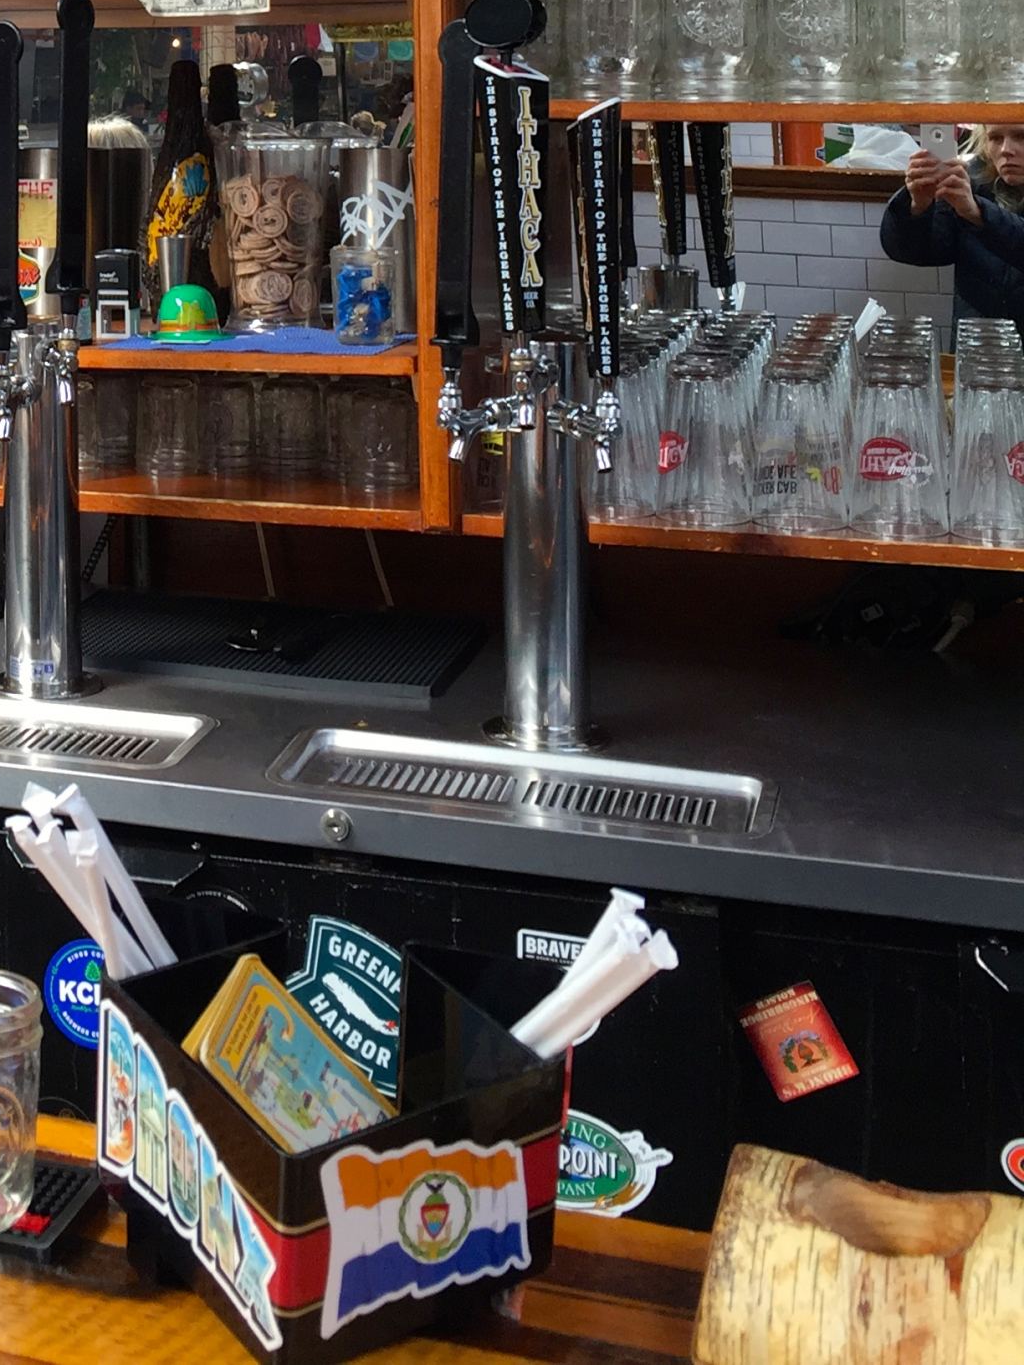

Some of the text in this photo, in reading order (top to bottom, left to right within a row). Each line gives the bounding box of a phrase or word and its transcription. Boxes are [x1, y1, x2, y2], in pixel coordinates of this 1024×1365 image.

[484, 76, 515, 331] THE SPIRIT OF THE FINGER LAKES
[517, 86, 544, 287] ITHACA
[592, 119, 612, 375] THE SPIRIT OF THE FINGER LAKES
[328, 934, 402, 995] GREEN
[526, 936, 586, 960] BRAVE
[309, 993, 392, 1069] HARBOR
[782, 1063, 854, 1098] BRONCK'S
[557, 1180, 595, 1196] PANY
[559, 1144, 618, 1180] POINT
